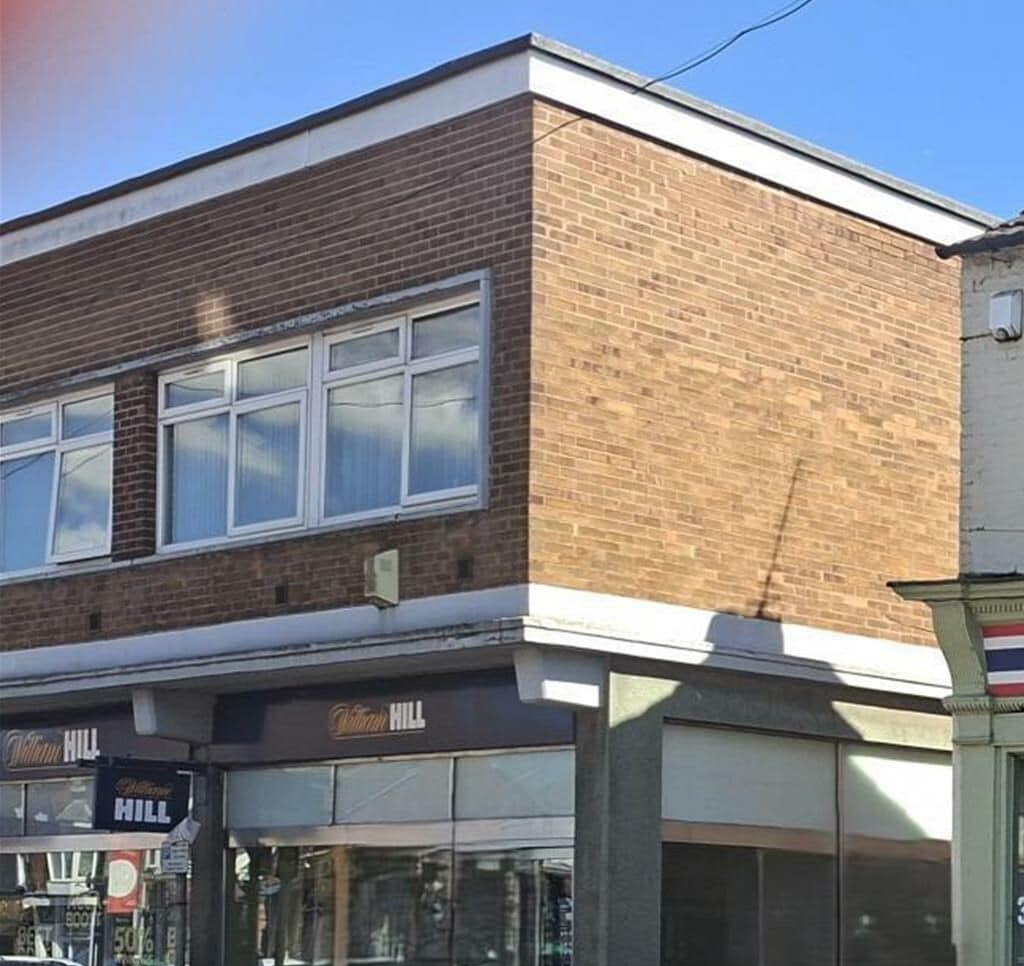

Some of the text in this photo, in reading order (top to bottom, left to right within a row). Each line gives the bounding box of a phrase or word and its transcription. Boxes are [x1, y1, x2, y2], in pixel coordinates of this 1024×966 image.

[389, 700, 426, 731] HILL
[63, 728, 100, 763] HILL
[114, 797, 171, 824] HILL
[114, 926, 154, 952] 50%
